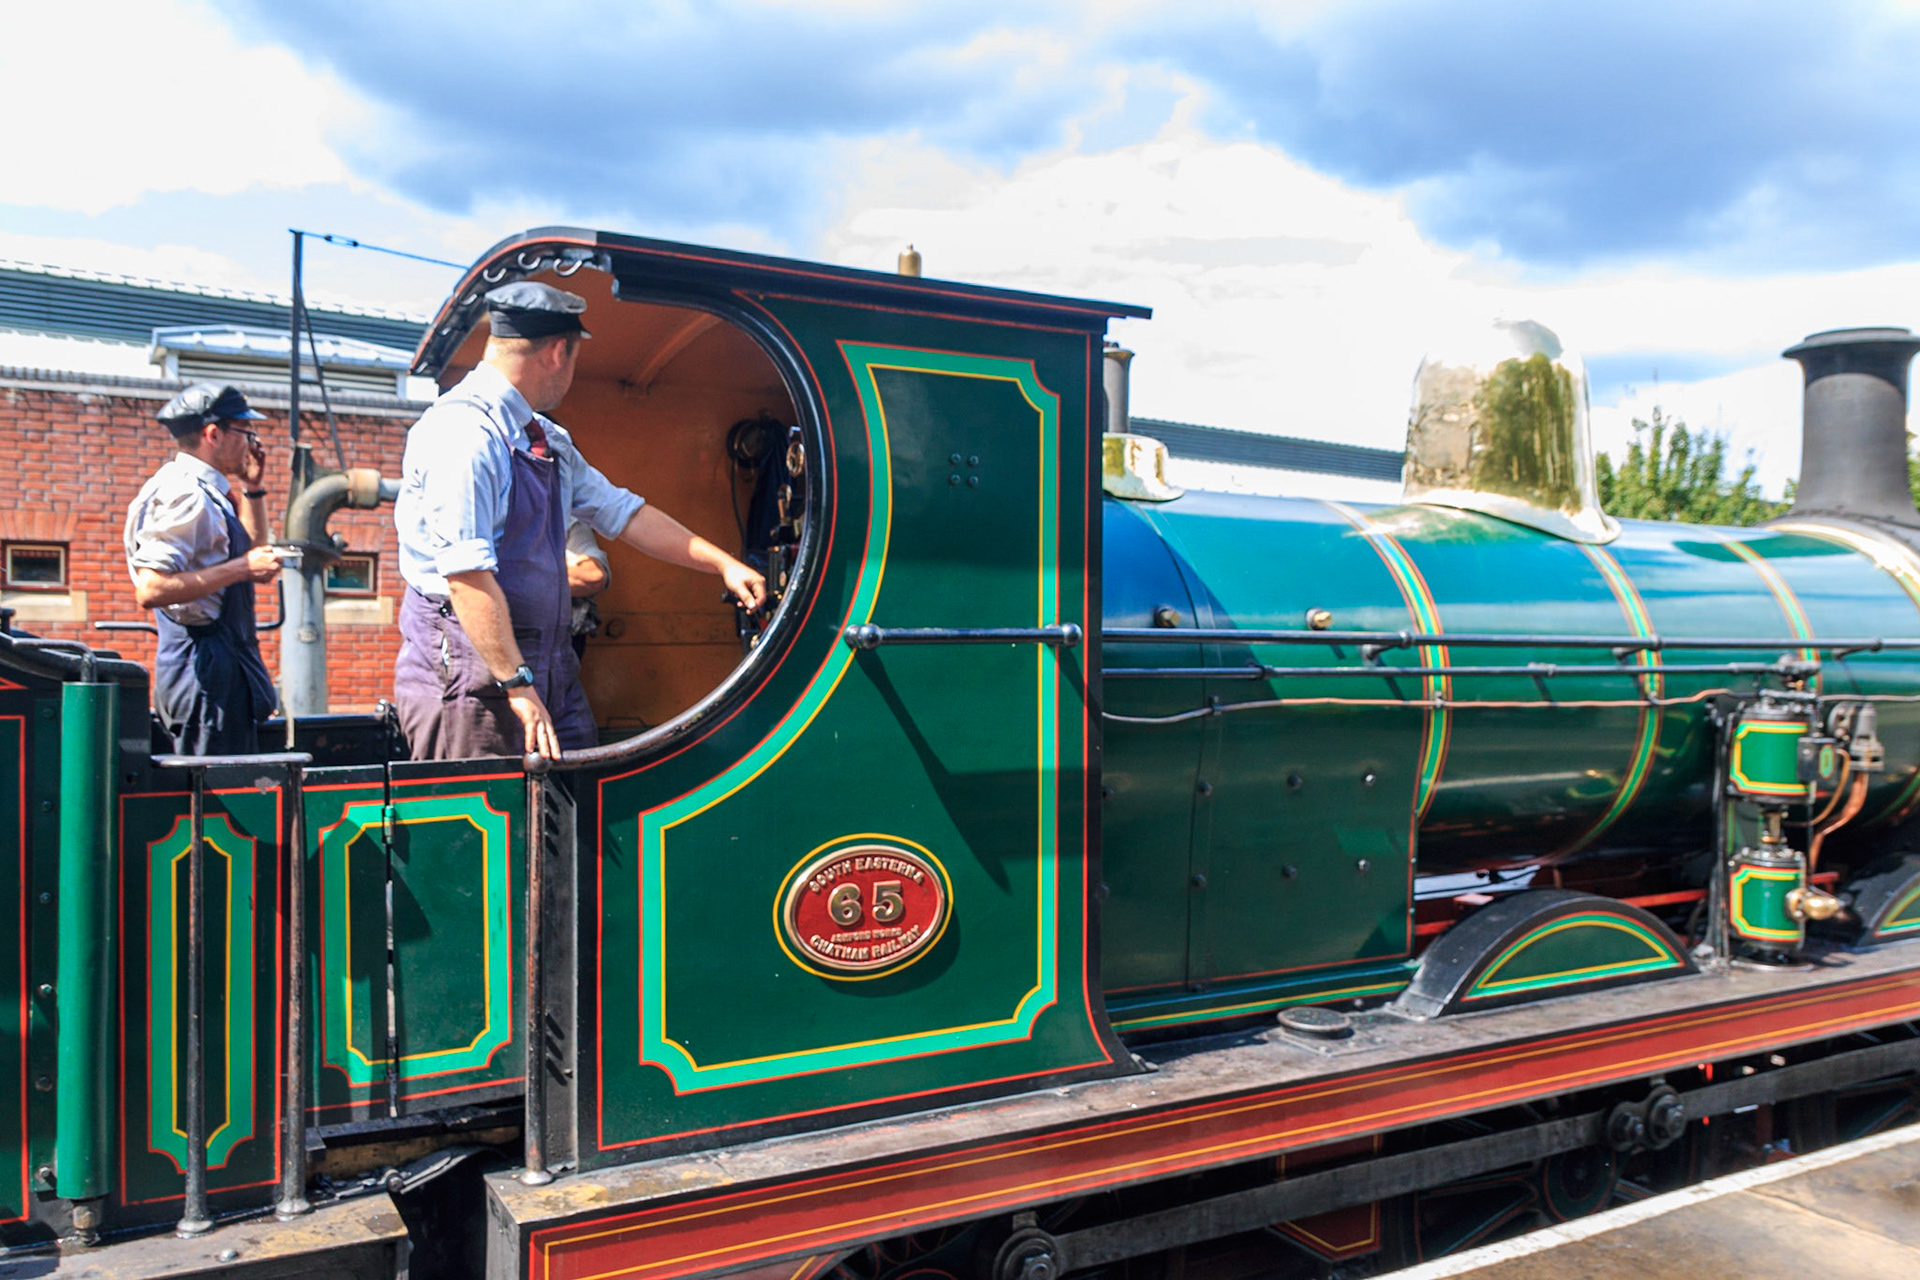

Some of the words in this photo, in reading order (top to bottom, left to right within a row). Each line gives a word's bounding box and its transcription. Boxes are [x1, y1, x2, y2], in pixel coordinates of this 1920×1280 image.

[809, 860, 852, 892] SOUTH
[827, 880, 904, 926] 65
[810, 934, 869, 960] CHATHAM
[871, 924, 920, 958] RAILWAY
